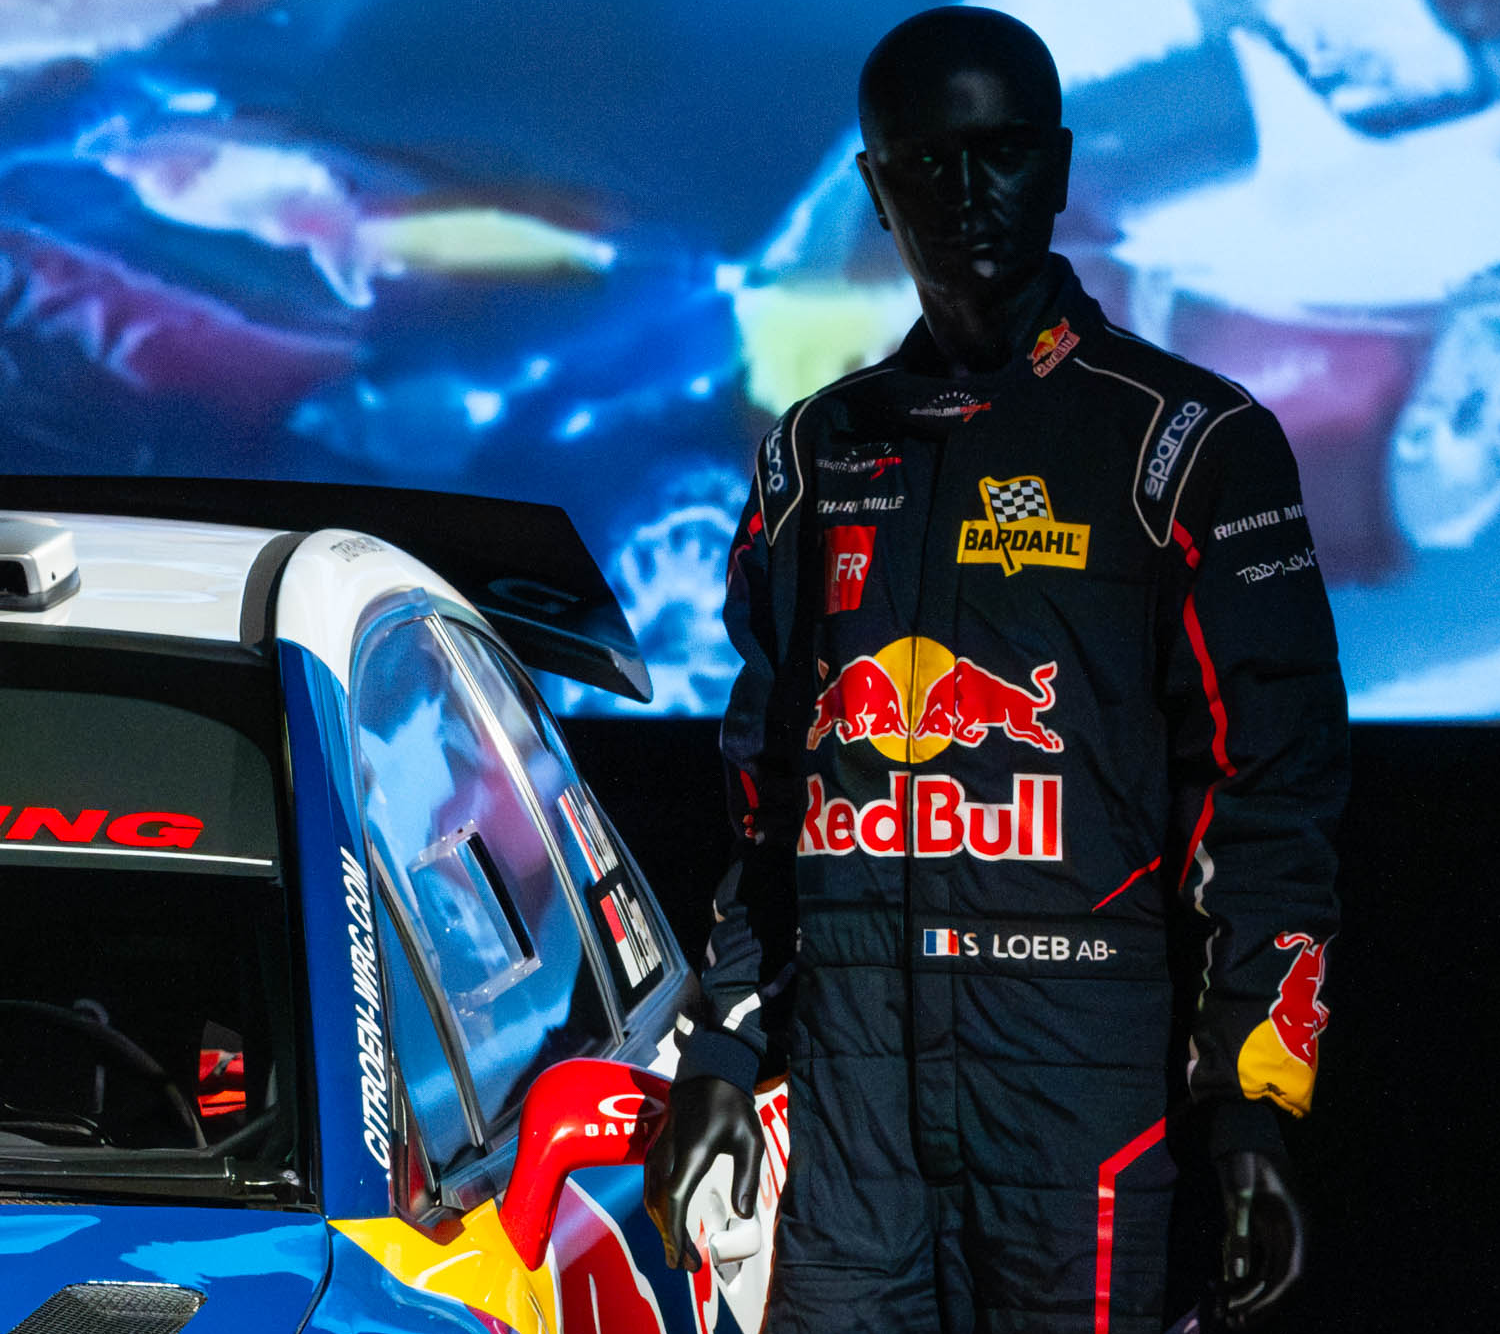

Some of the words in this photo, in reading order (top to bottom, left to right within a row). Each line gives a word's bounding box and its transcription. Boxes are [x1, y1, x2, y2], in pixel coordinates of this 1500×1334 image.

[1144, 399, 1208, 501] sparco
[964, 528, 1080, 556] BARDAHL
[835, 551, 870, 582] FR
[992, 933, 1071, 961] LOEB
